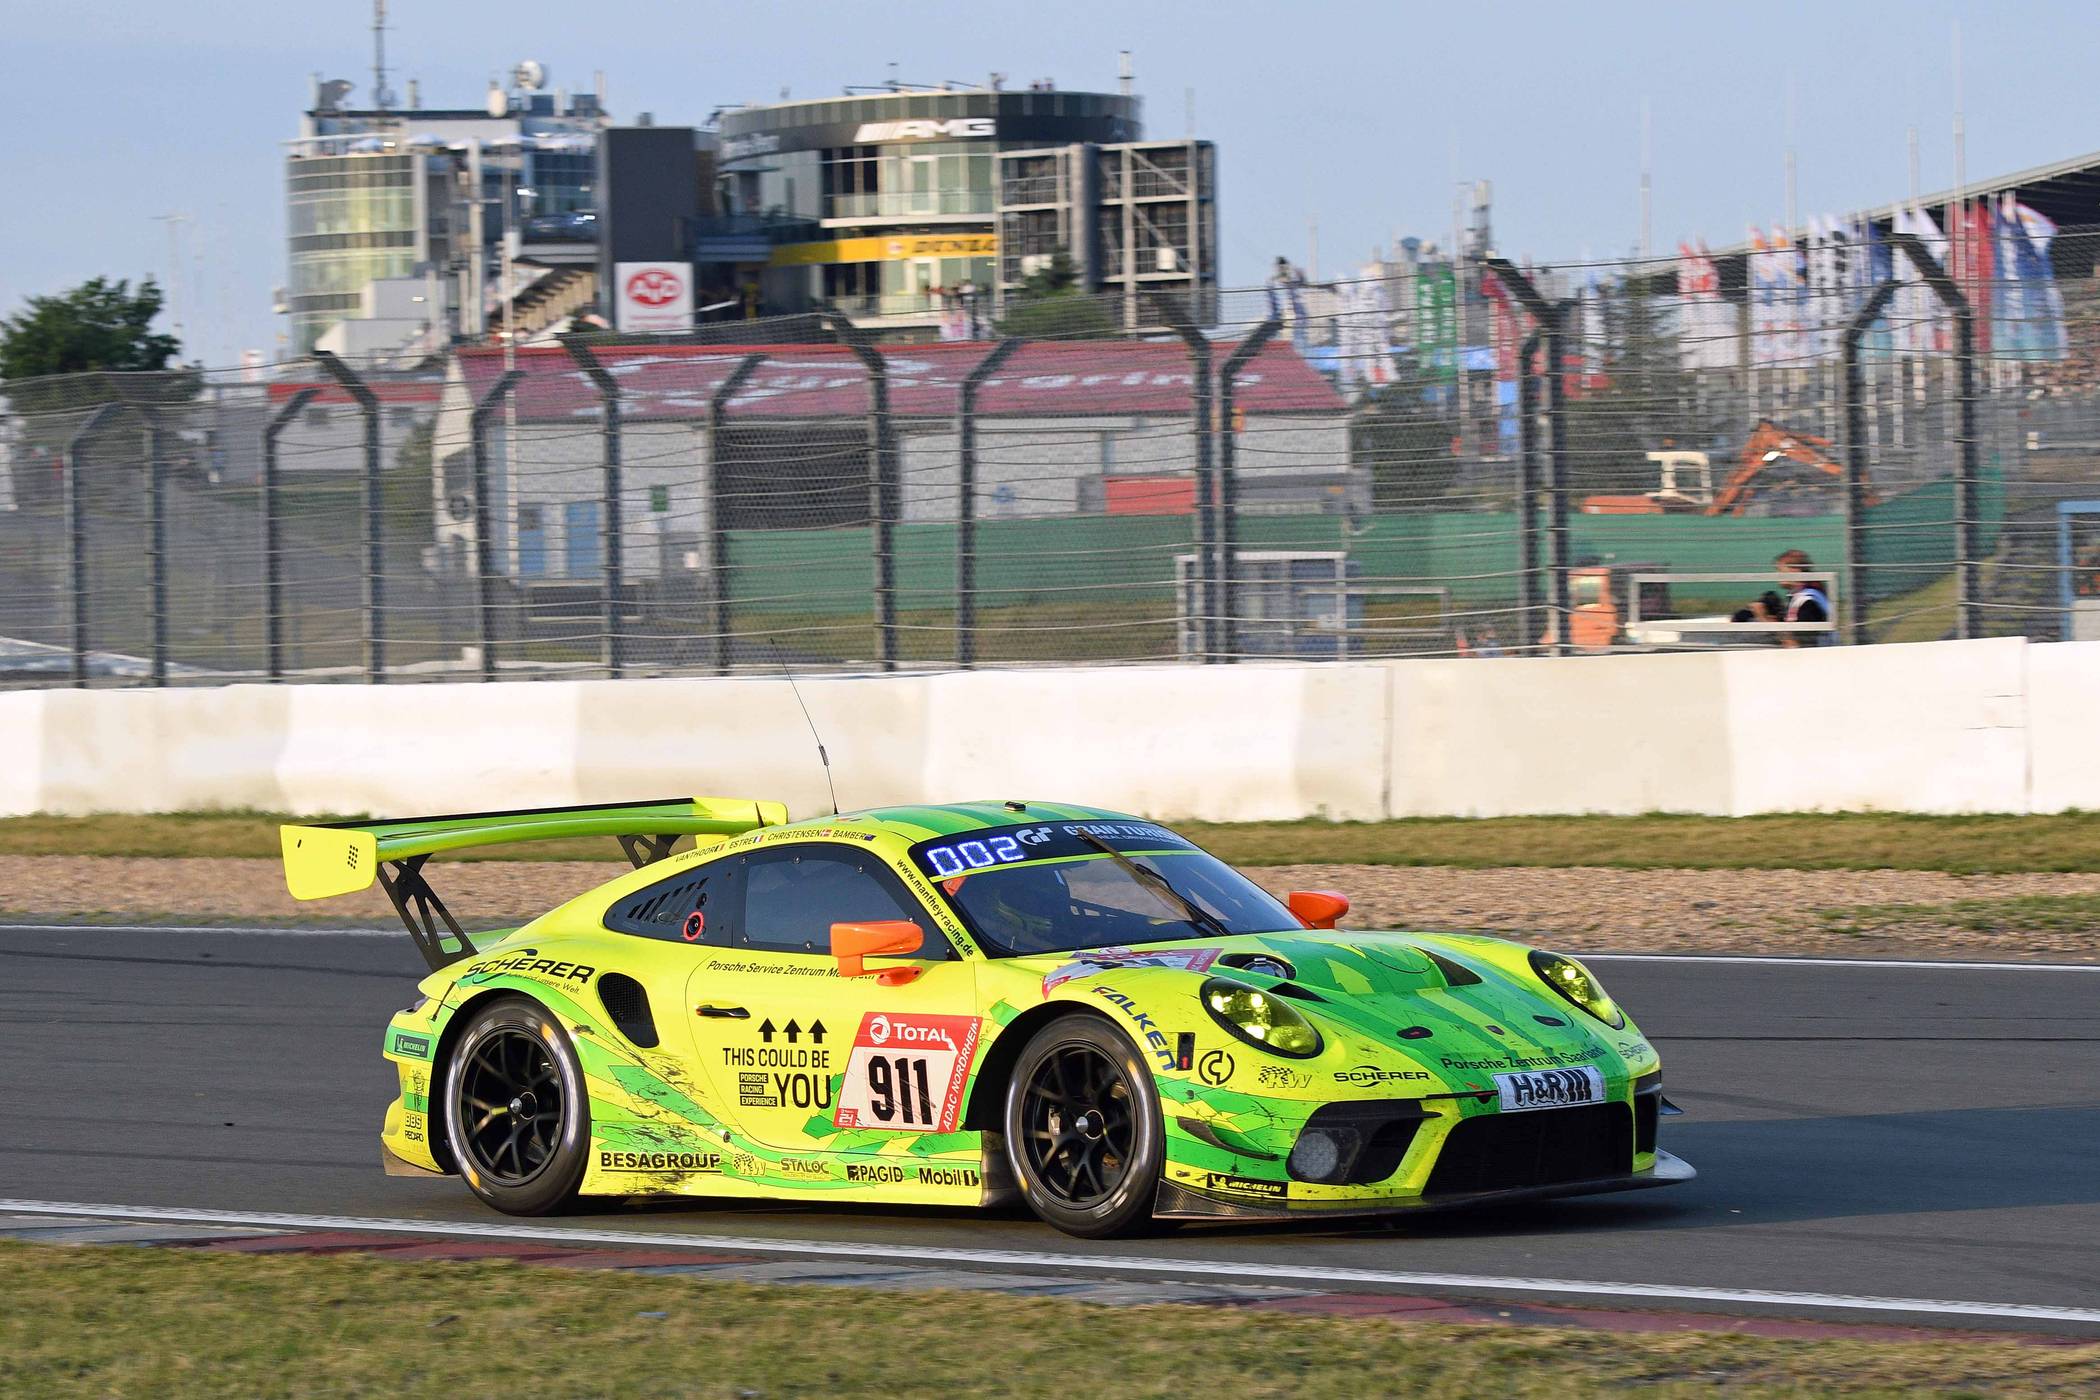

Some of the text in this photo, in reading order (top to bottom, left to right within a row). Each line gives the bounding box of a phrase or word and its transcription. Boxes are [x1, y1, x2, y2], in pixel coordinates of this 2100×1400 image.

[886, 118, 997, 138] AMG
[729, 837, 754, 849] ESTRE
[767, 829, 822, 841] CHRISTENSEN
[832, 829, 866, 840] BAMBER
[926, 836, 1025, 877] 002
[896, 858, 974, 957] www.manthey-racing.de
[461, 957, 596, 985] SCHERER
[707, 959, 746, 973] Porsche
[746, 962, 784, 975] Service
[784, 963, 827, 977] Zentrum
[892, 1022, 951, 1043] TOTAL
[1091, 985, 1177, 1072] FALKEN
[722, 1047, 830, 1069] THIS COULD BE
[1440, 1055, 1504, 1071] Porsche
[1503, 1051, 1563, 1068] Zentrum
[740, 1073, 768, 1083] PORSCHE
[1264, 1070, 1313, 1090] KW
[1333, 1070, 1431, 1083] SCHERER
[740, 1085, 763, 1095] RACING
[773, 1073, 832, 1109] YOU
[867, 1055, 934, 1126] 911
[741, 1096, 777, 1106] EXPERIENCE
[404, 1113, 422, 1130] BBS
[942, 1093, 958, 1132] ADAC
[600, 1152, 721, 1169] BESAGROUP
[737, 1158, 767, 1176] KW
[780, 1157, 831, 1174] STALOC
[859, 1165, 904, 1183] PAGID
[918, 1167, 962, 1186] Mobil
[1228, 1180, 1282, 1194] MICHELIN
